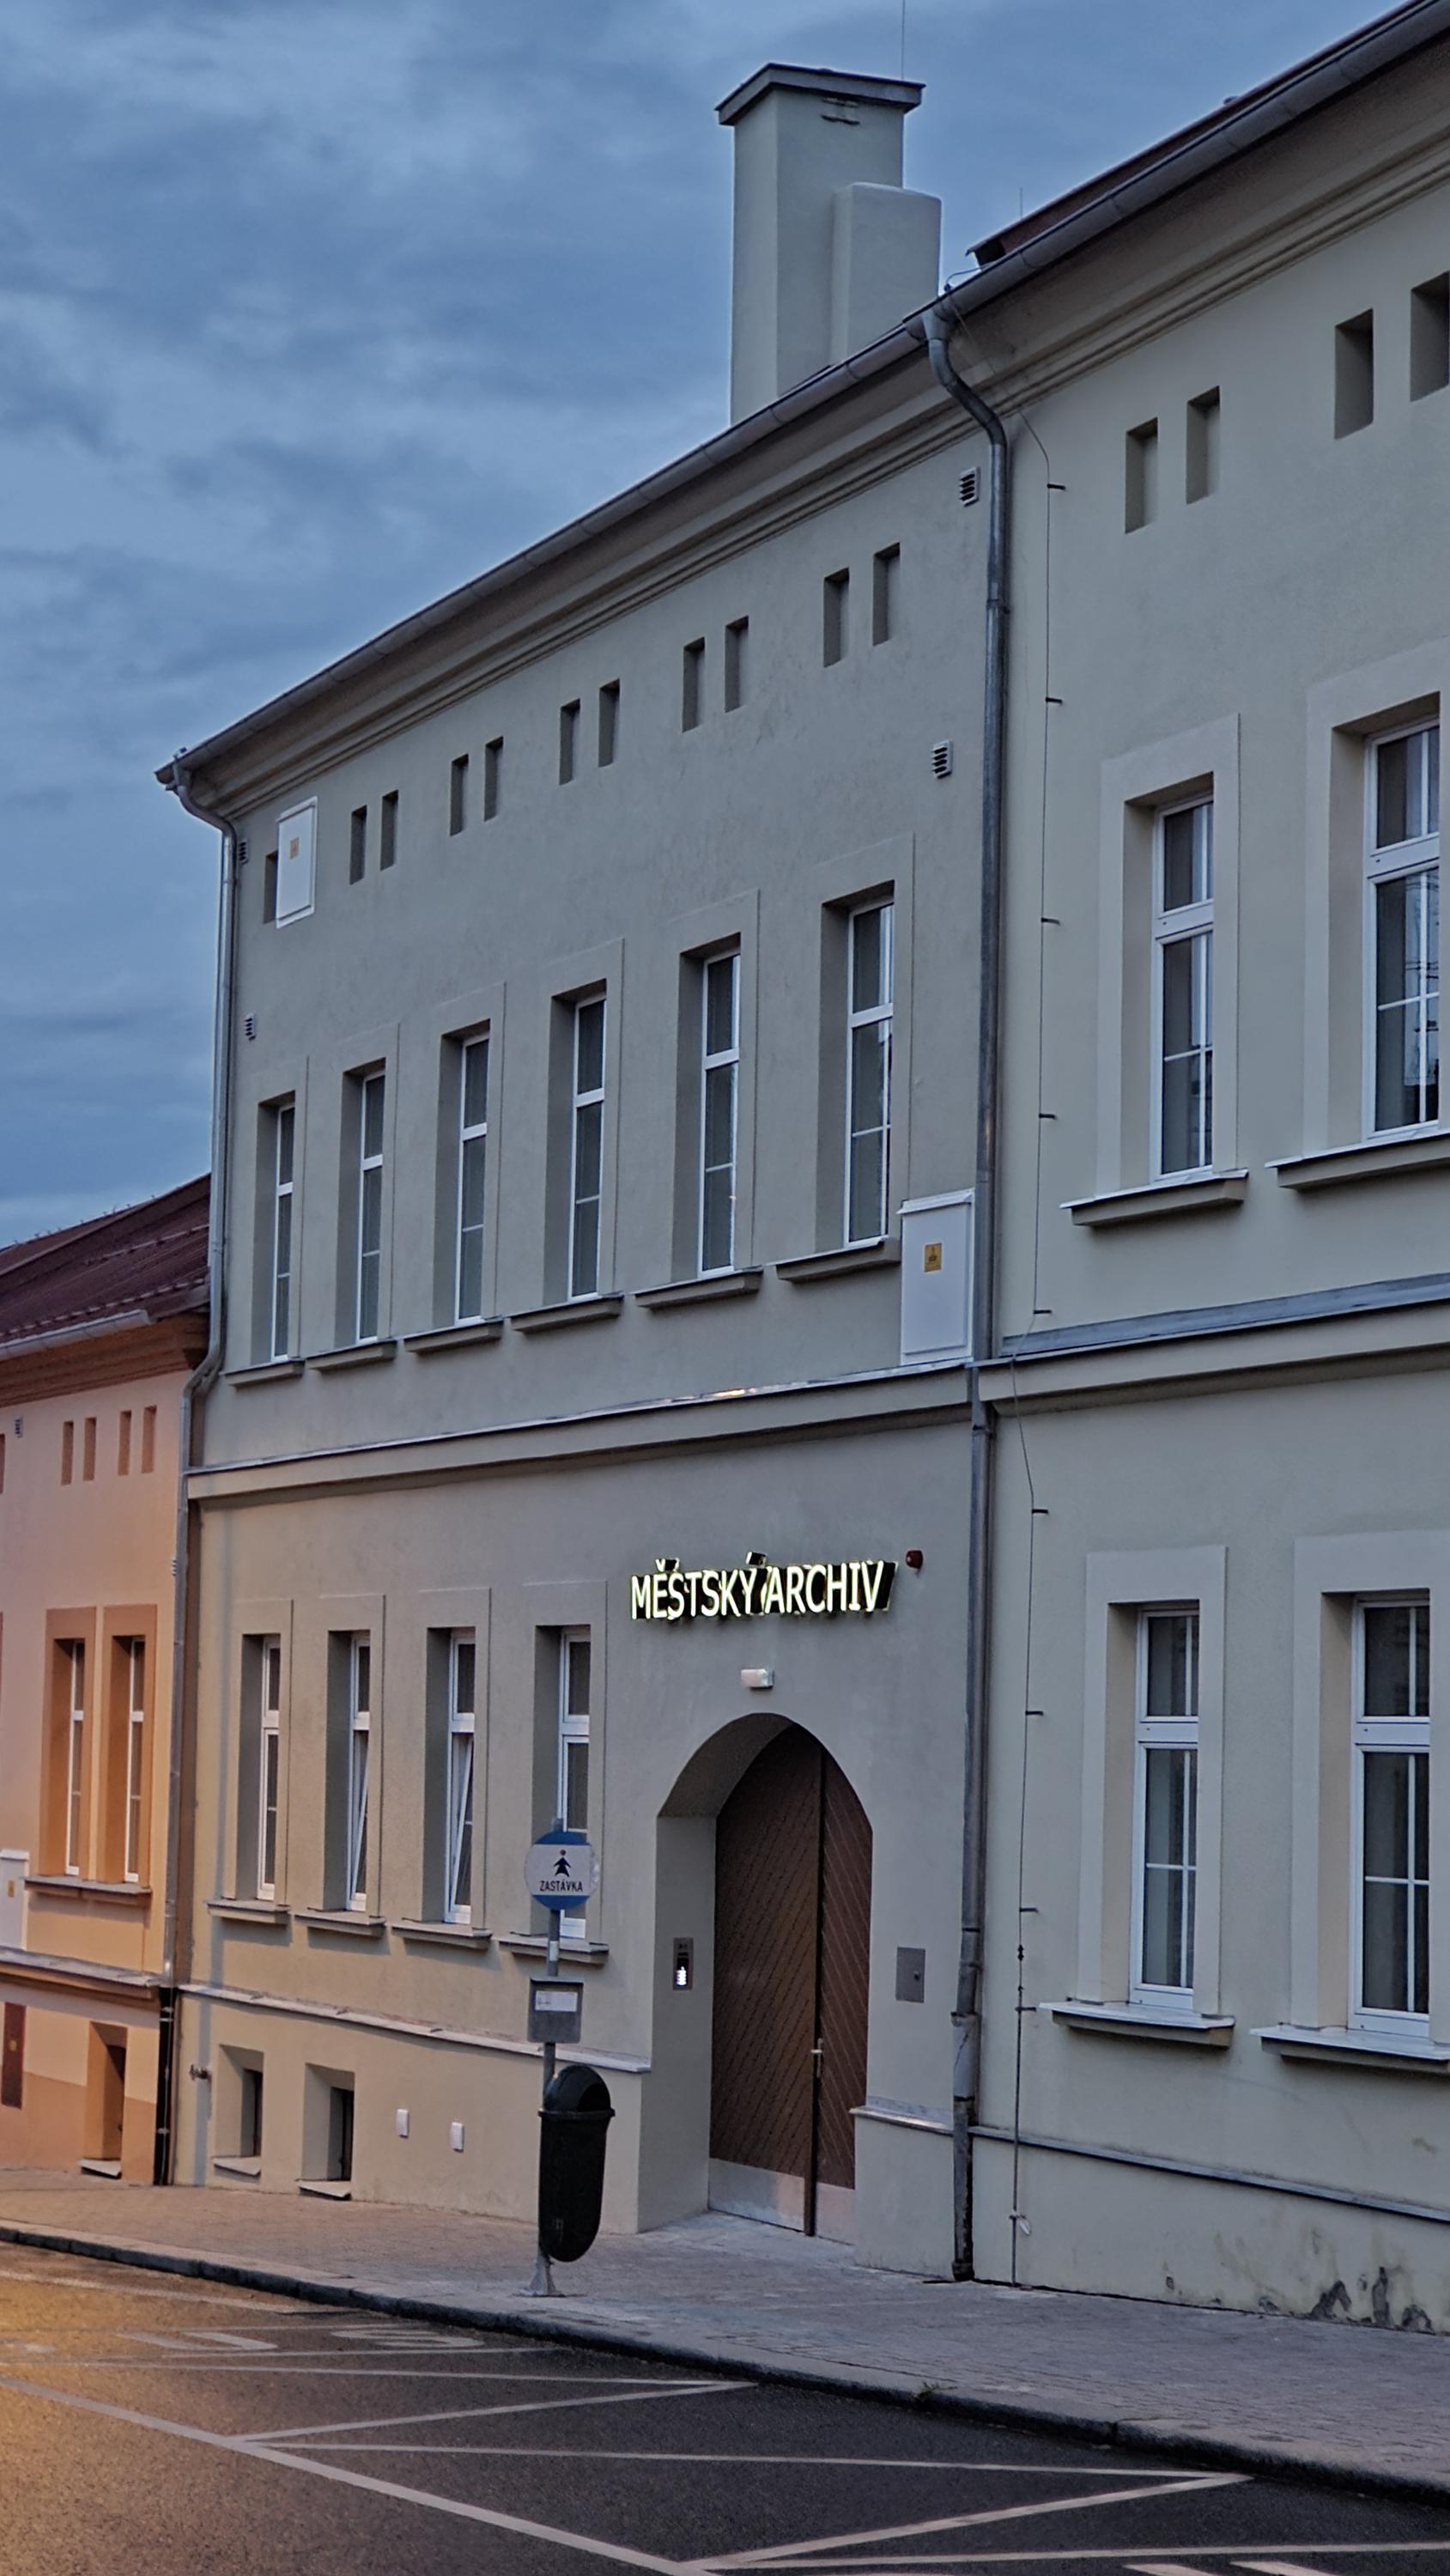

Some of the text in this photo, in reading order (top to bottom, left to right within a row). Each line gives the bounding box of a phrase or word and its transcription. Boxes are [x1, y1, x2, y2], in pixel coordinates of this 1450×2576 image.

[631, 1551, 888, 1620] MĚSTSKÝ ARCHIV
[539, 1879, 584, 1892] ZASTÁVKA
